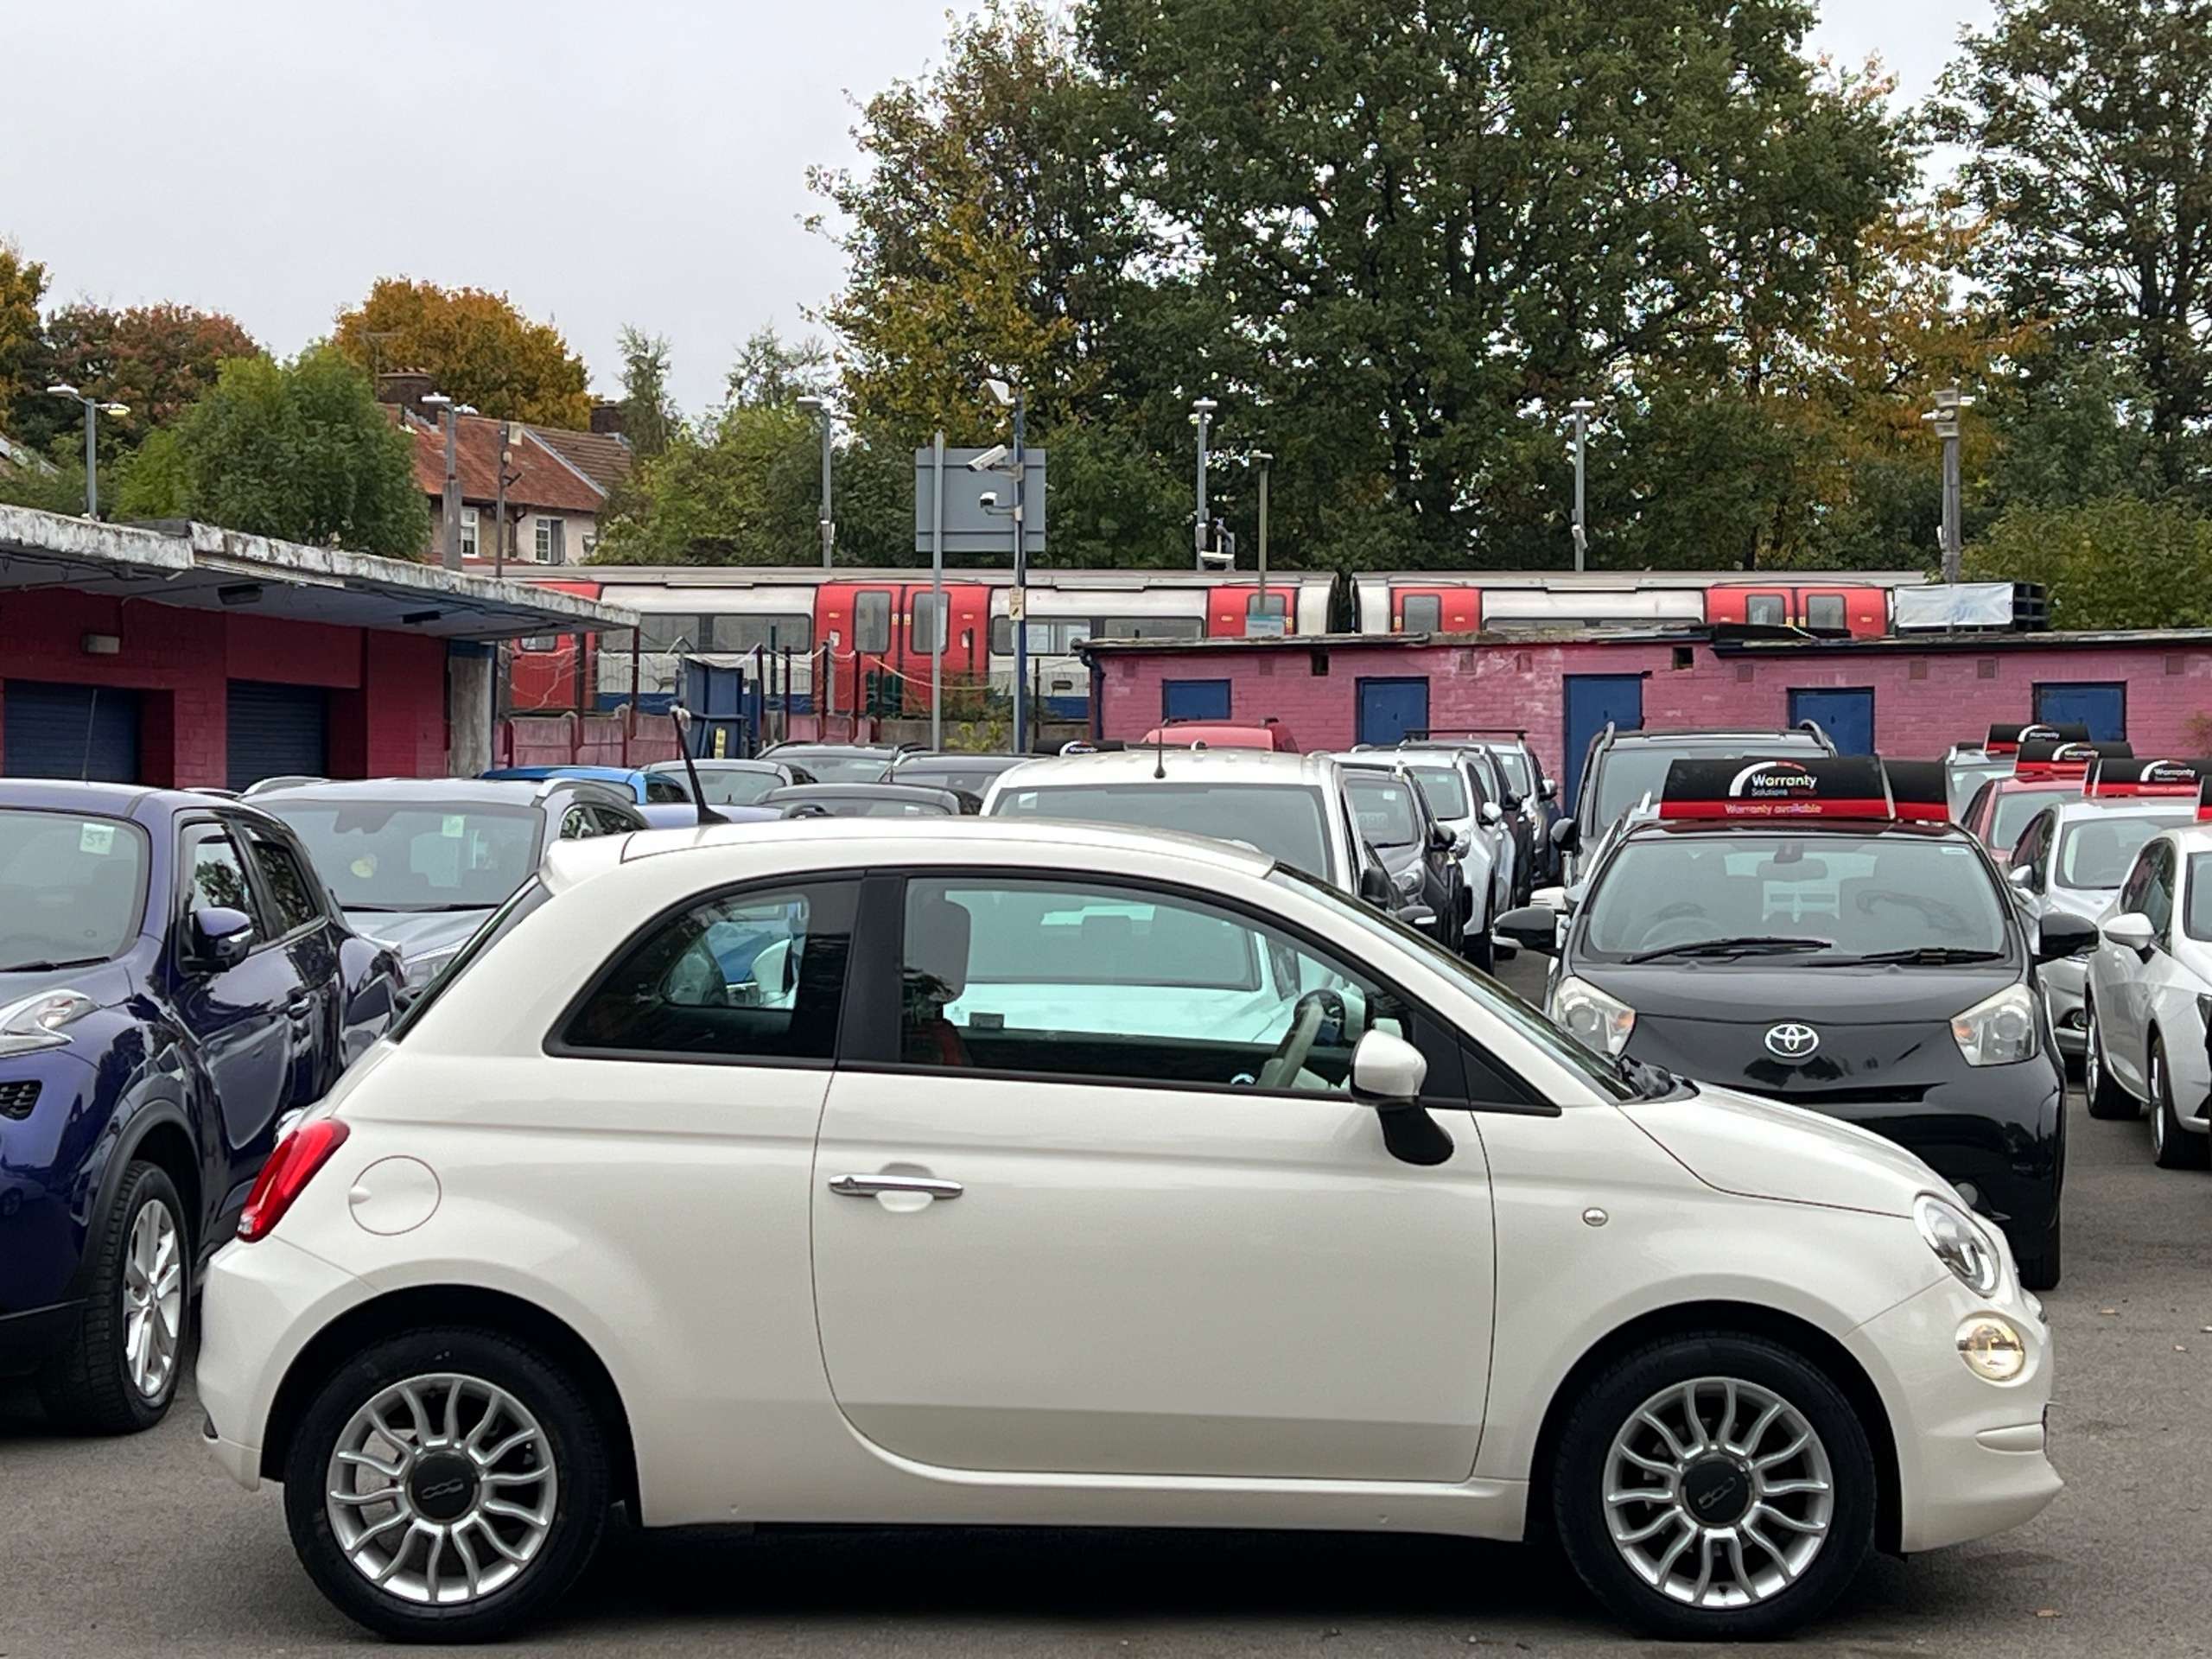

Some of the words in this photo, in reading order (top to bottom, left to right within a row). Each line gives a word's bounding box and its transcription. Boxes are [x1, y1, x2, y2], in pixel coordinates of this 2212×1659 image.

[2153, 767, 2196, 778] Warranty
[1751, 774, 1818, 790] Warranty
[1751, 787, 1789, 797] Solutions
[1724, 804, 1772, 815] Warranty
[1774, 803, 1822, 814] available
